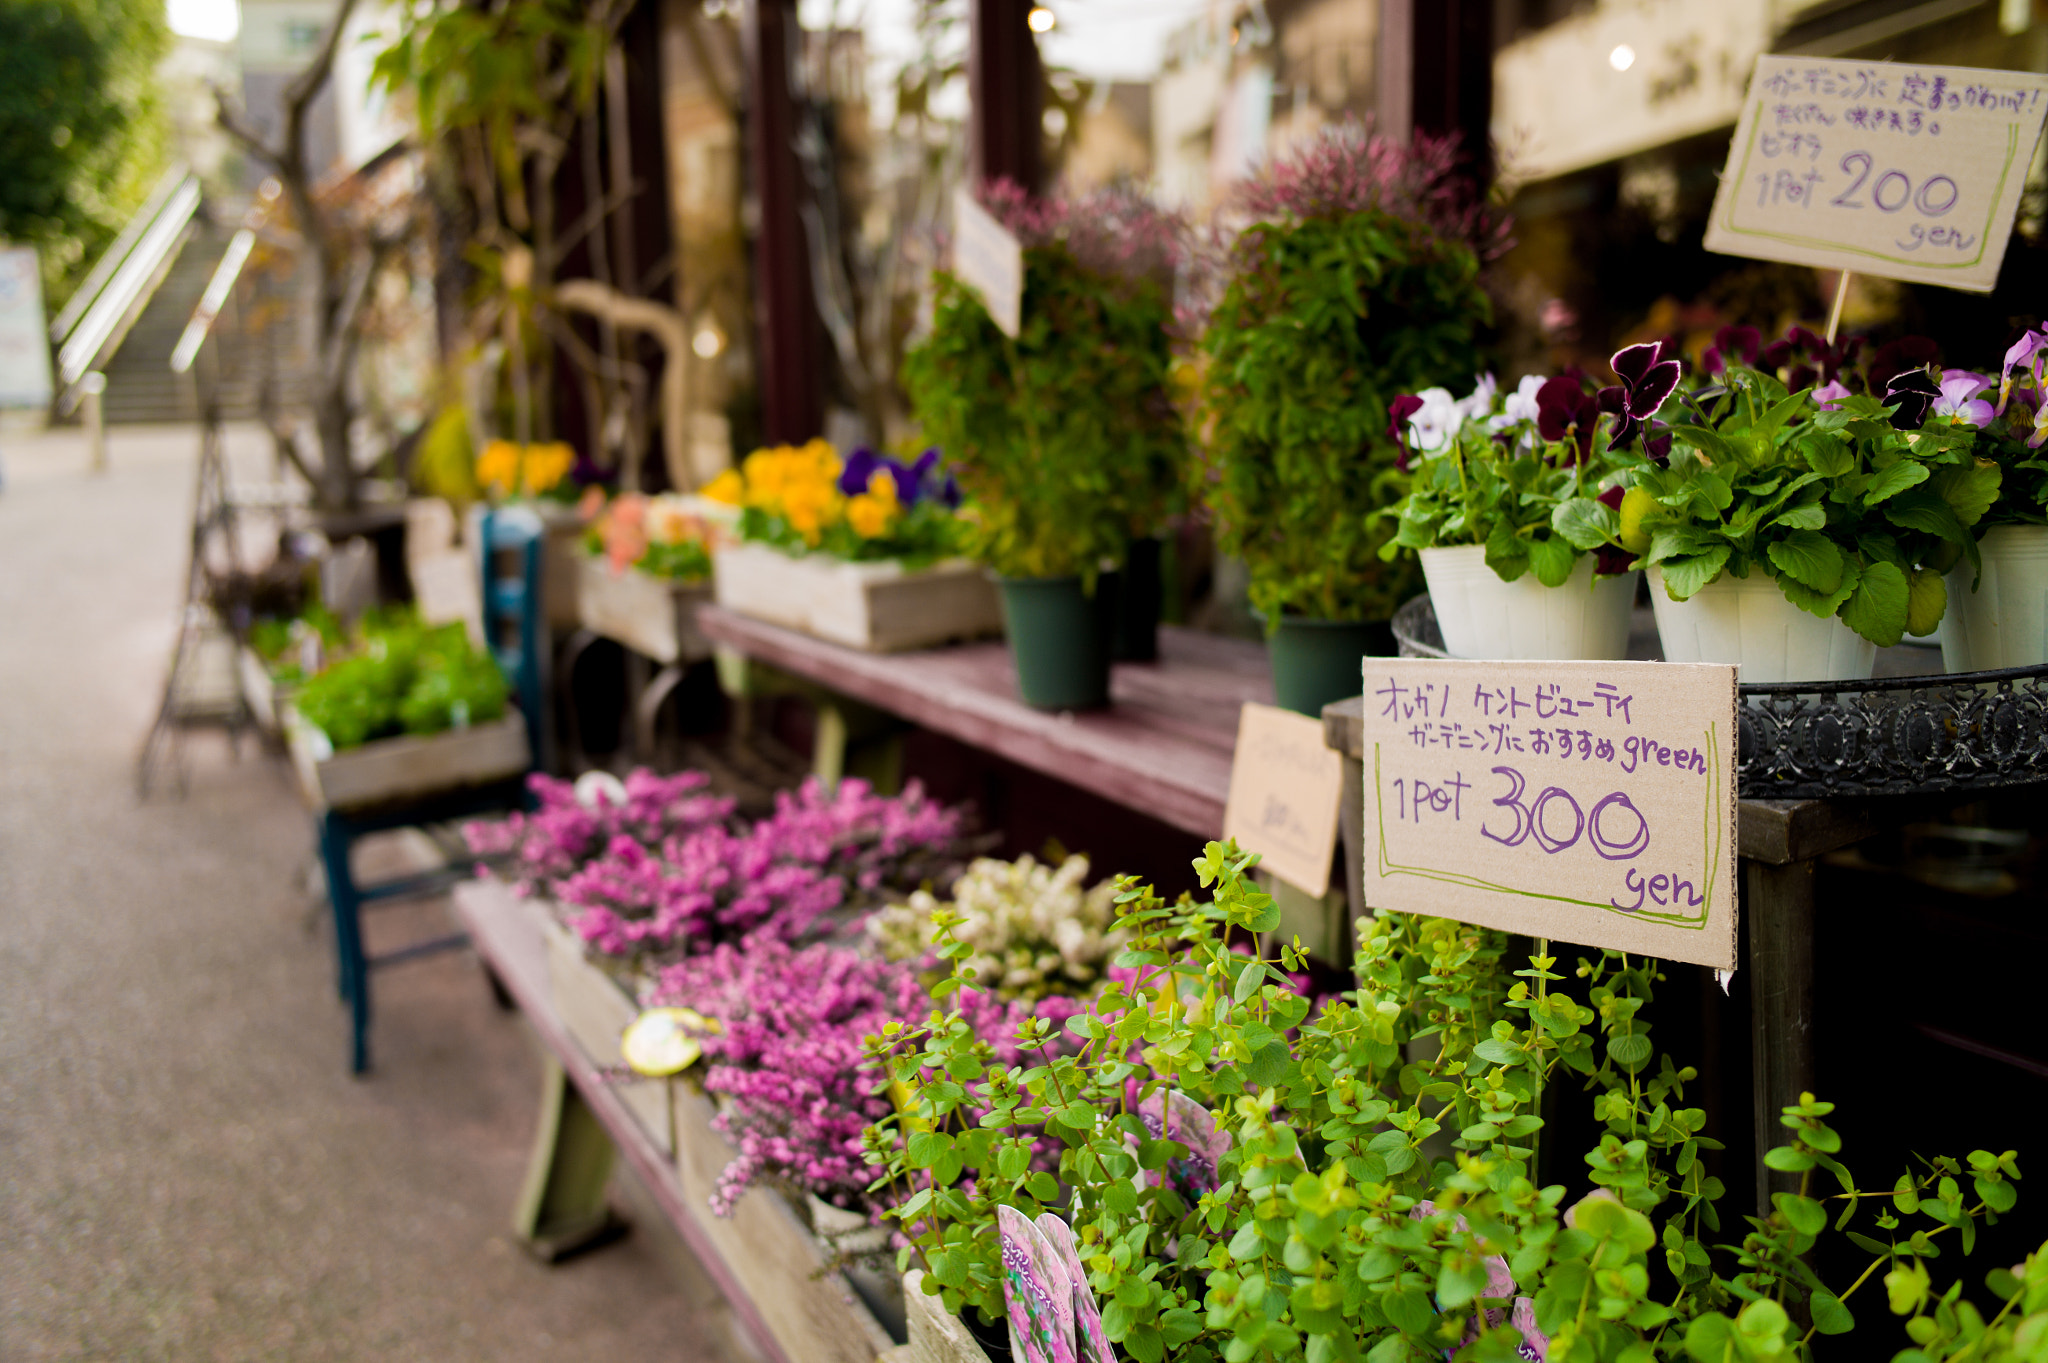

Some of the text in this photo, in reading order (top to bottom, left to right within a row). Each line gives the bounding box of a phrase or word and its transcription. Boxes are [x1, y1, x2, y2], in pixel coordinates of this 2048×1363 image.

[1829, 150, 1959, 218] 200
[1376, 677, 1633, 725] オレガノ ケントビューティ
[1620, 736, 1707, 773] green
[1481, 766, 1650, 860] 300
[1611, 868, 1705, 912] yen
